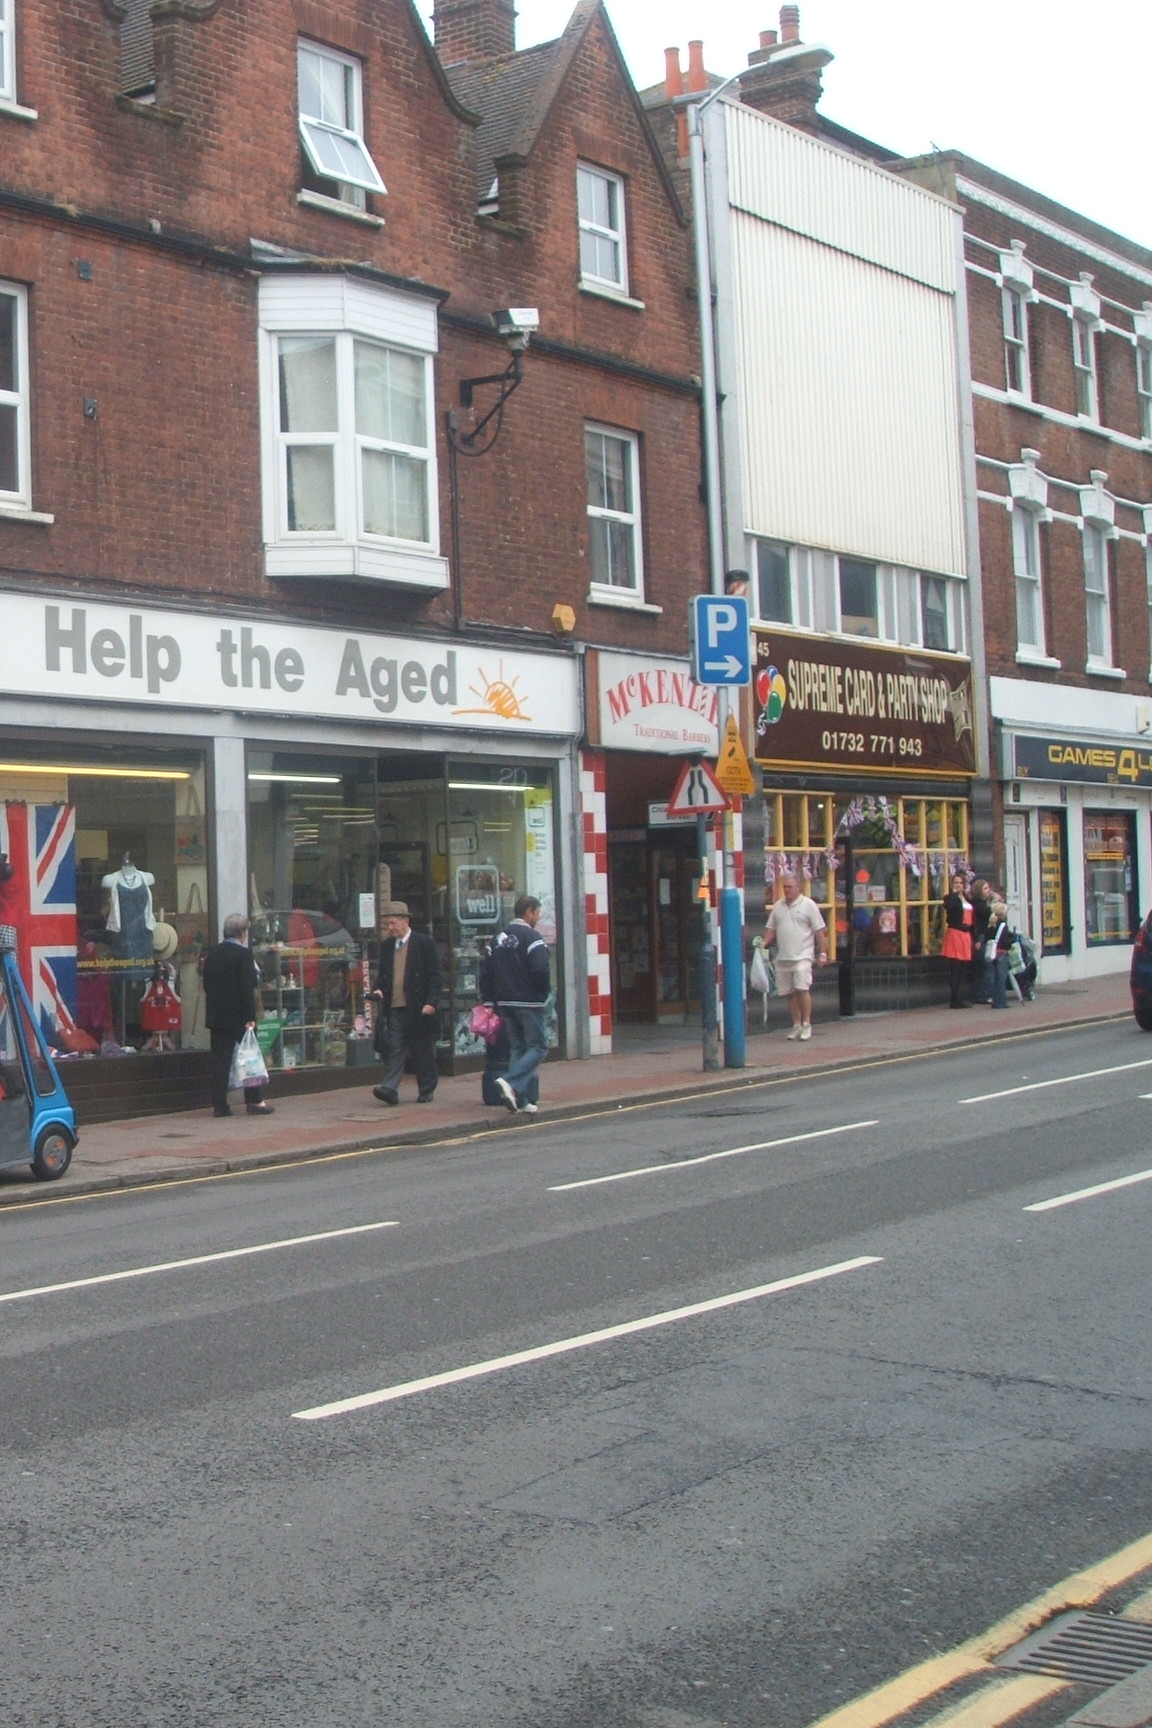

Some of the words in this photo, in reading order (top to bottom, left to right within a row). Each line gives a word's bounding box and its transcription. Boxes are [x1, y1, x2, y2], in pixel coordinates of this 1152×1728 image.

[707, 603, 737, 648] P
[45, 605, 182, 694] Help
[216, 626, 305, 692] the
[335, 638, 458, 713] Aged
[758, 642, 770, 657] 45
[788, 659, 844, 713] SUPREME
[845, 667, 875, 717] CARD
[877, 674, 886, 718] &
[886, 673, 919, 721] PARTY
[920, 677, 948, 723] SHOP
[822, 731, 864, 752] 01732
[870, 735, 894, 753] 771
[899, 737, 923, 756] 943
[467, 895, 496, 913] well
